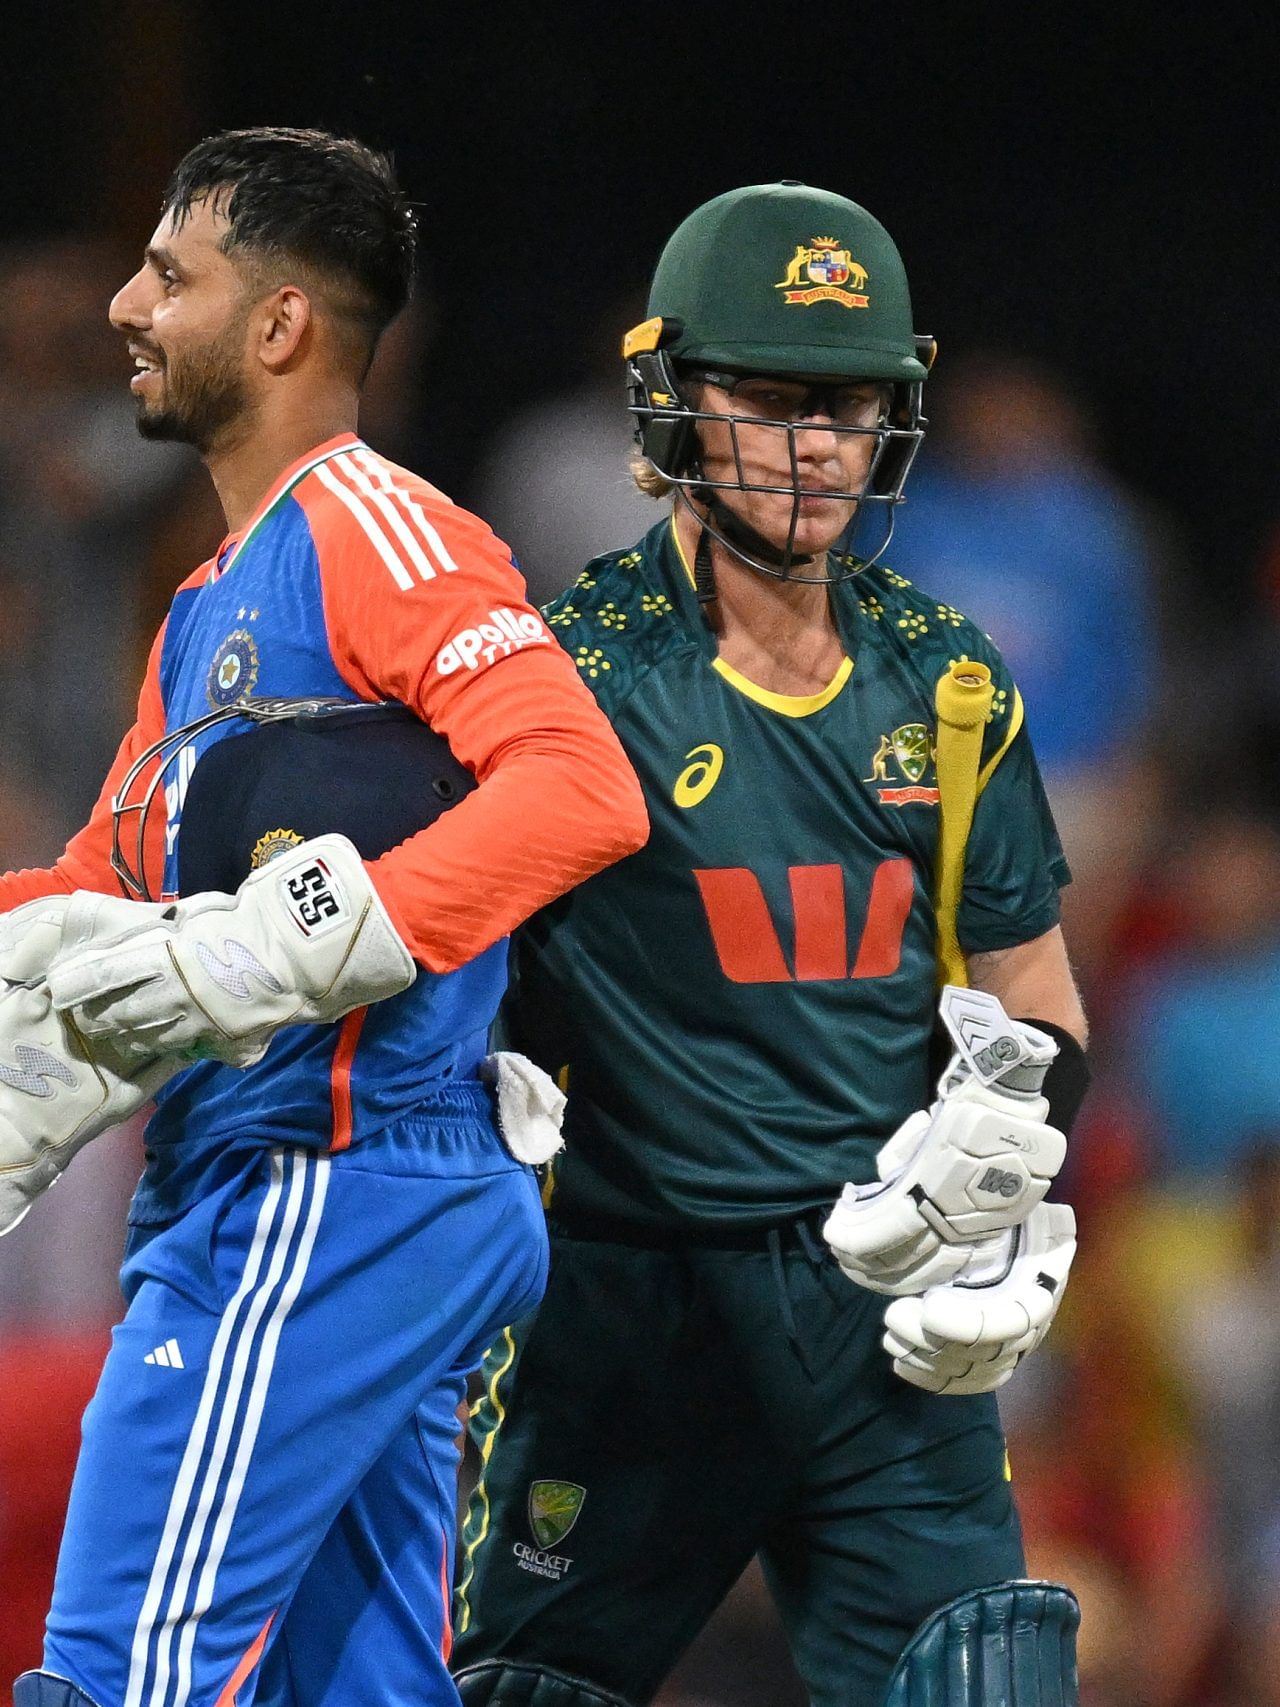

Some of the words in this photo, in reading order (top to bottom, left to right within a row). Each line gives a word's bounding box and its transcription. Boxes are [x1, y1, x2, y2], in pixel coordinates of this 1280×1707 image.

[436, 608, 543, 675] apollo
[287, 866, 340, 927] SS
[513, 1542, 574, 1573] CRICKET
[517, 1558, 561, 1581] AUSTRALIA
